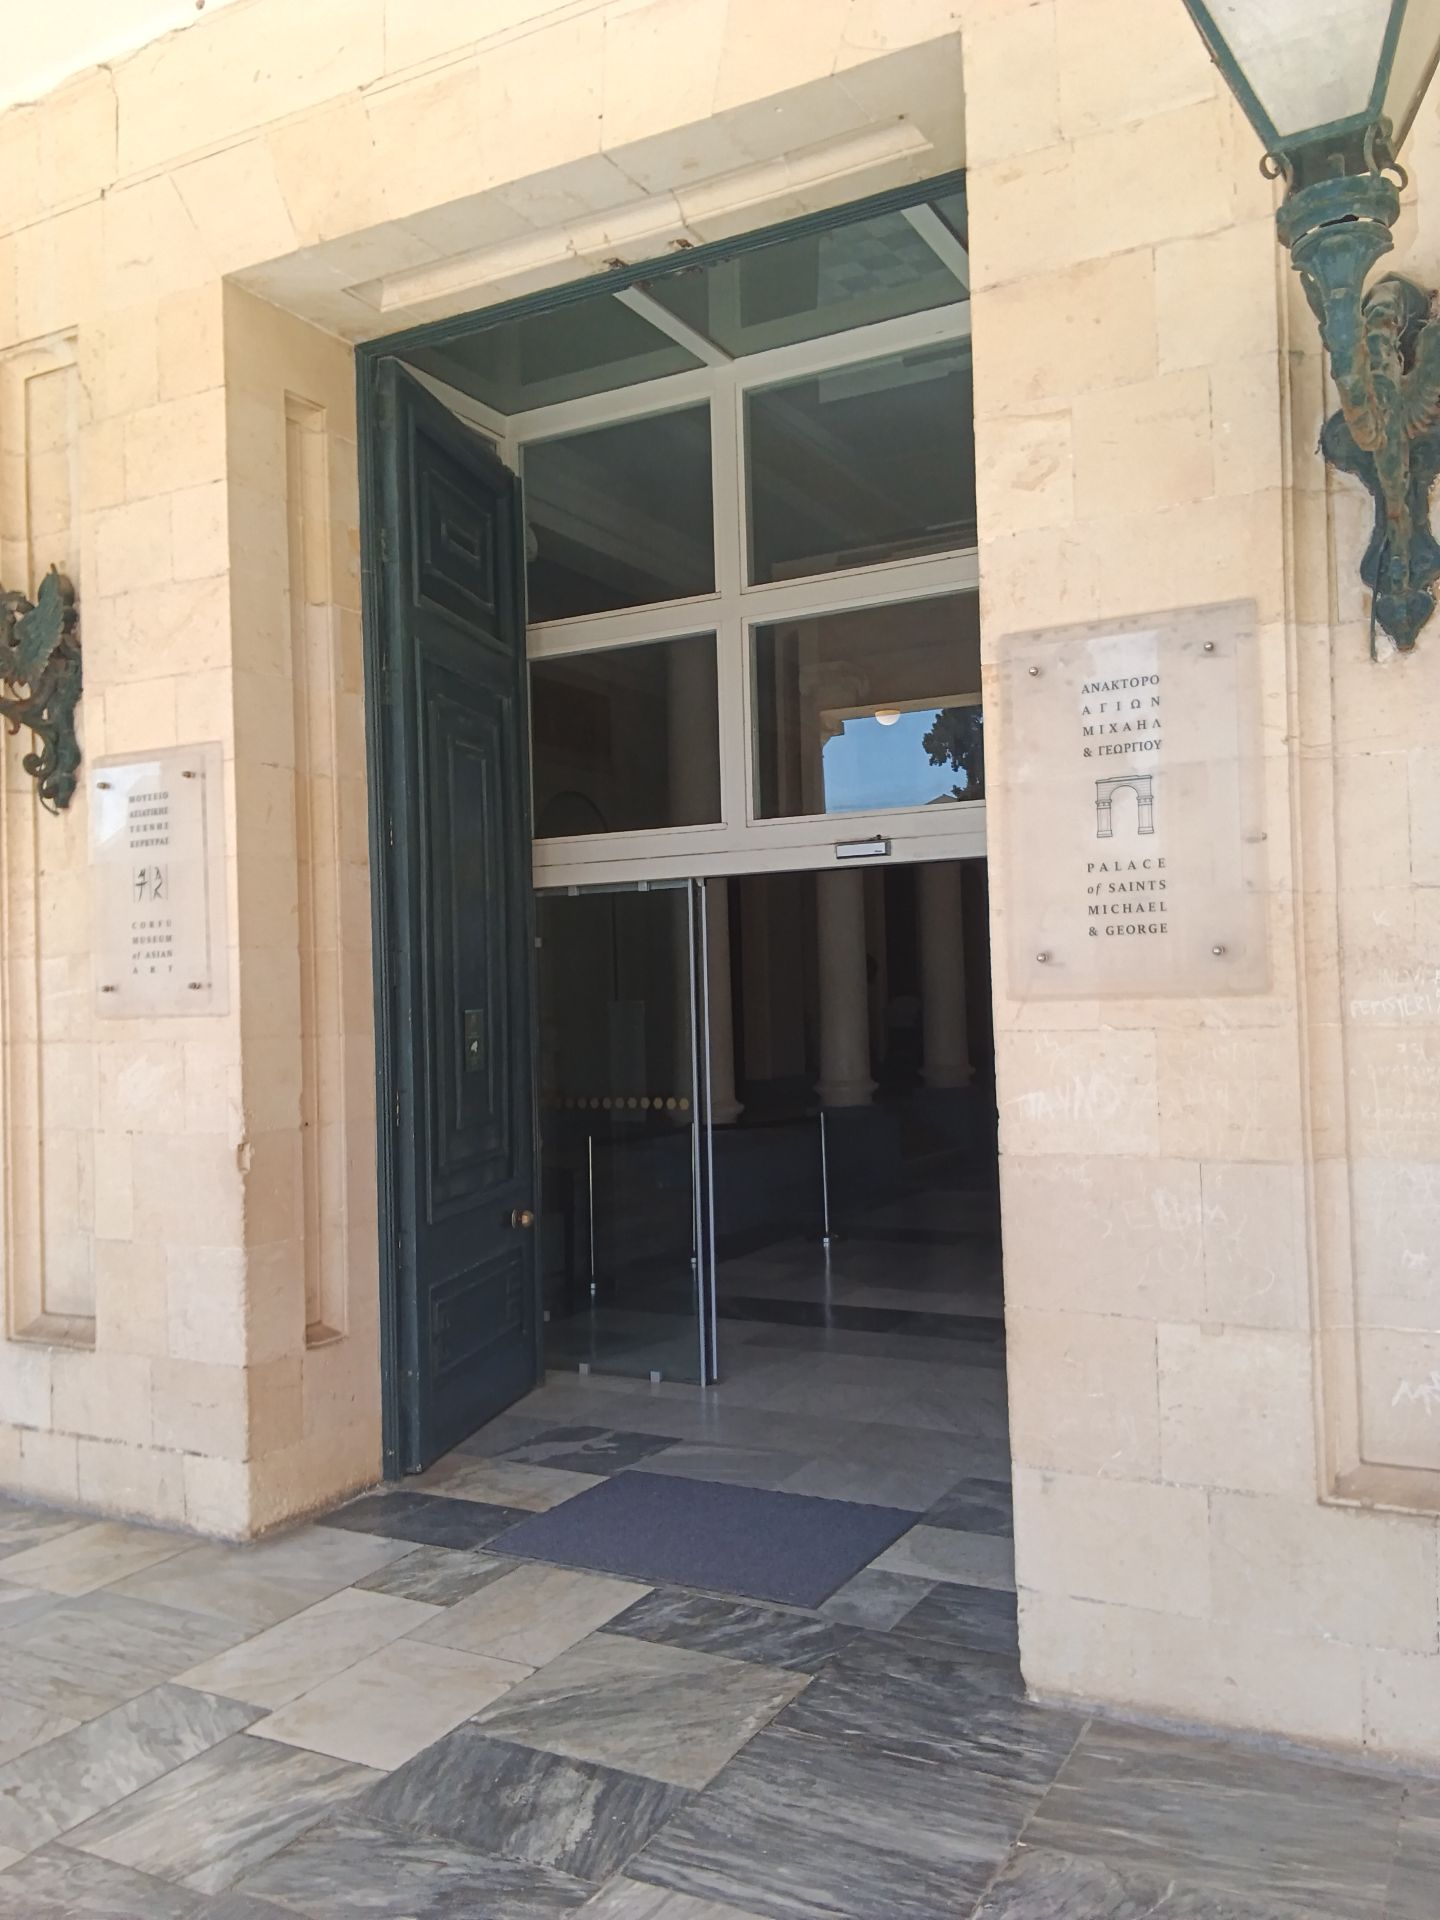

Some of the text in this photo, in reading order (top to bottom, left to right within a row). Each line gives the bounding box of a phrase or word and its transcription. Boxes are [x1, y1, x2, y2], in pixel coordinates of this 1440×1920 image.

[1081, 674, 1160, 694] ΑΝΑΚΤΟΡΟ
[1082, 696, 1160, 715] ΑΓΙΩΝ
[1083, 718, 1161, 736] ΜΙΧΑΗΛ
[1083, 739, 1162, 757] & ΓΕΩΡΓΙΟΥ
[1087, 857, 1166, 873] PALACE
[1087, 879, 1166, 896] of SAINTS
[1088, 901, 1167, 915] MICHAEL
[132, 919, 172, 929] CORFU
[1088, 923, 1168, 937] & GEORGE
[132, 935, 172, 944] MUSEUM
[145, 950, 173, 959] ASIAN
